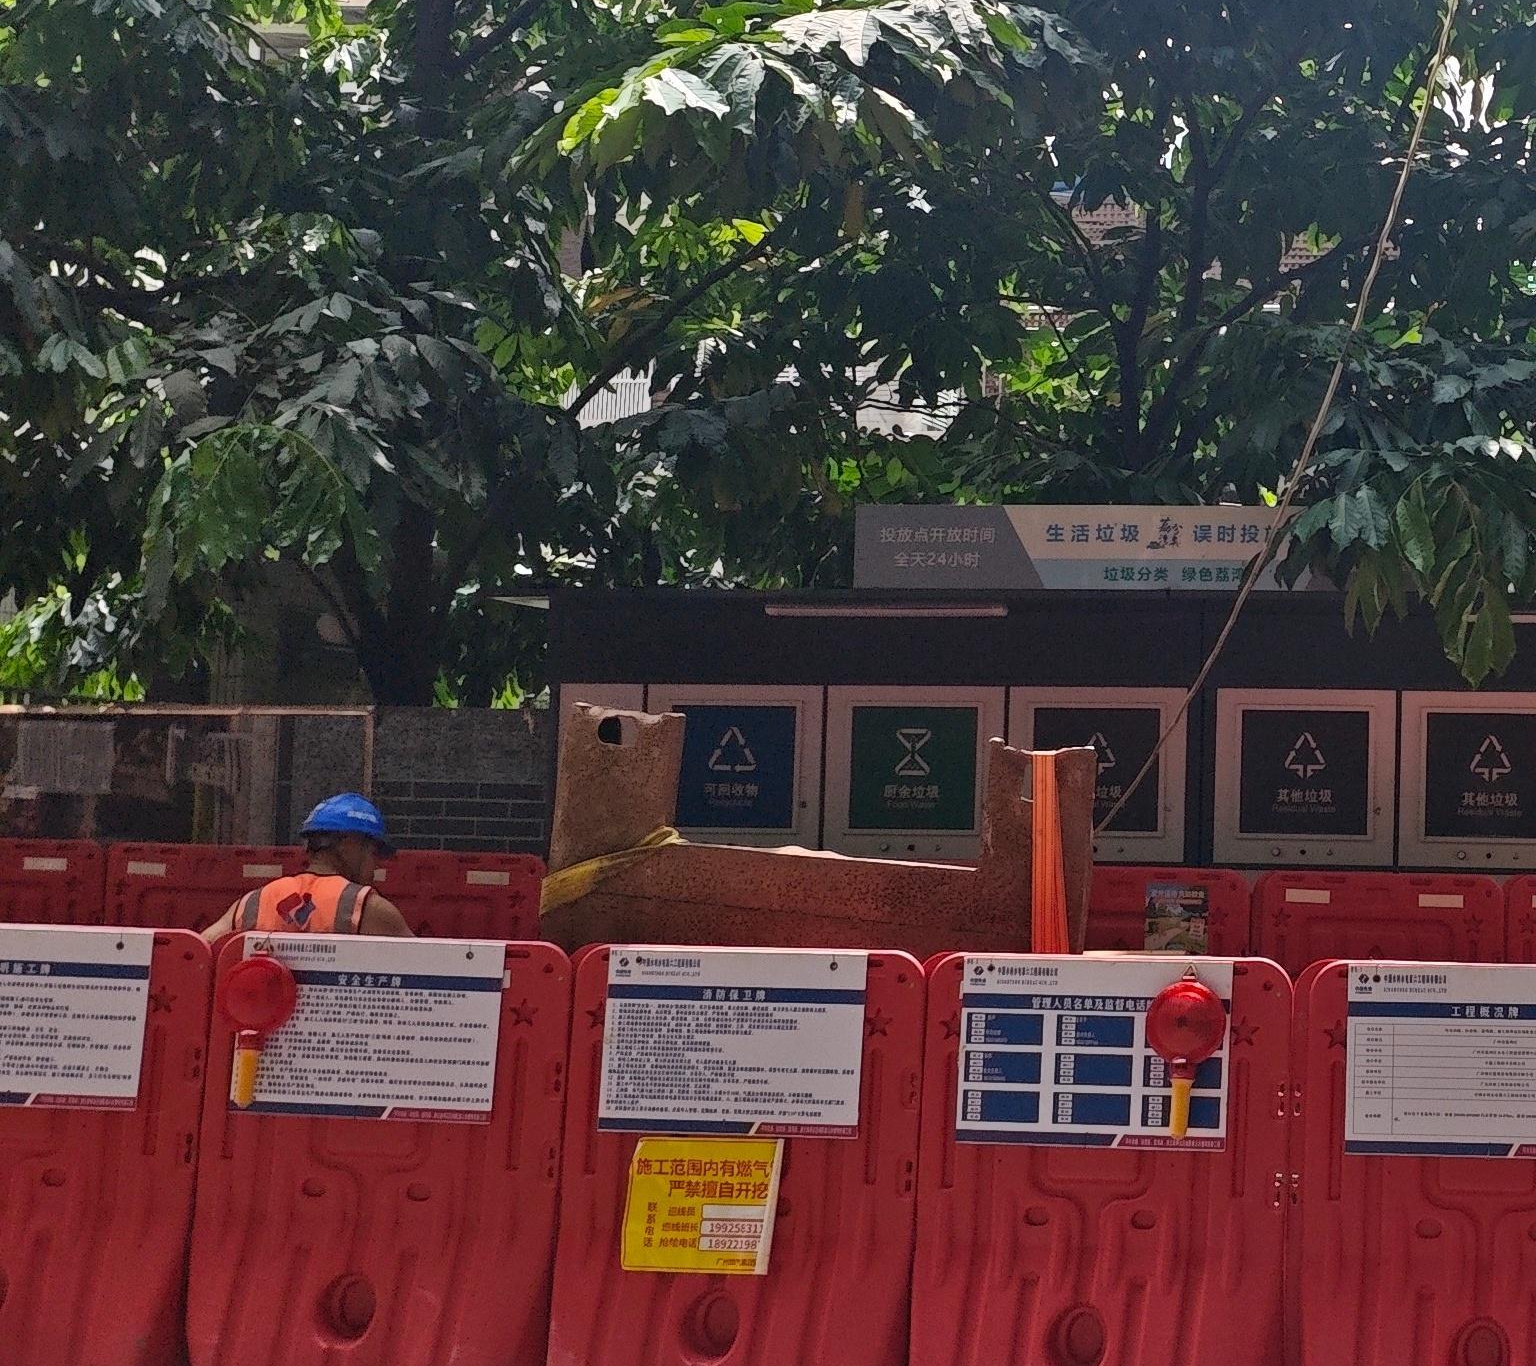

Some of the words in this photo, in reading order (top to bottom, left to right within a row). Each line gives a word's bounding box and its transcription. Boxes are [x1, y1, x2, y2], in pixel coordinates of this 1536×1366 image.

[880, 526, 997, 546] 投放点开放时间
[1045, 524, 1140, 543] 生活垃圾
[893, 550, 982, 569] 全天24小时
[1103, 566, 1169, 583] 垃圾分类
[704, 782, 760, 797] 可回收物
[882, 784, 941, 799] 厨余垃圾
[1276, 787, 1334, 804] 其他垃圾
[1461, 791, 1519, 807] 其他垃圾
[337, 974, 403, 988] 安全生产牌
[702, 988, 767, 1003] 消防保卫牌
[1451, 1005, 1521, 1019] 工程概况牌
[636, 1157, 775, 1178] 施工范围内有燃气
[668, 1179, 769, 1200] 严禁擅自开挖
